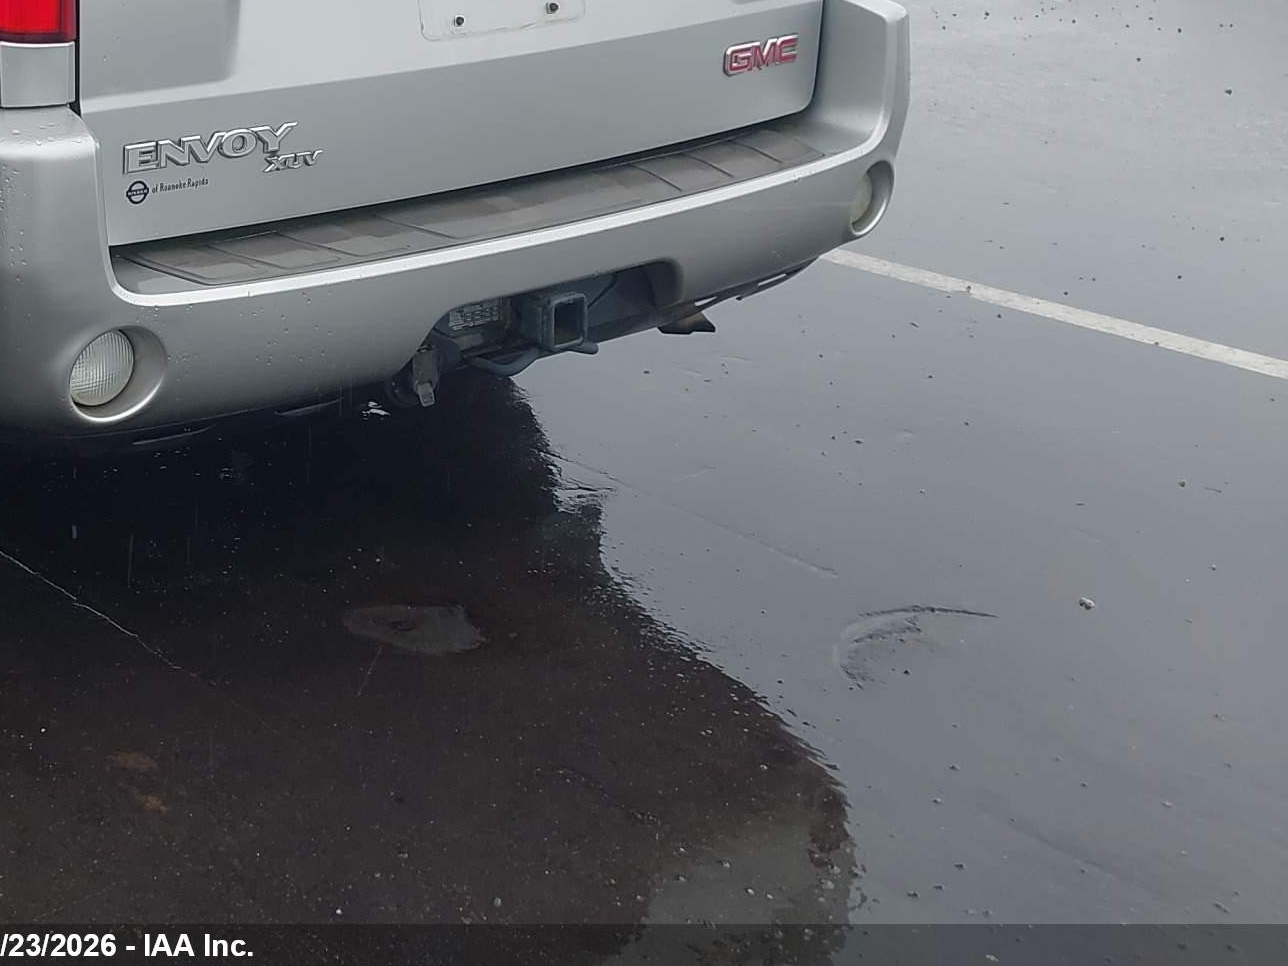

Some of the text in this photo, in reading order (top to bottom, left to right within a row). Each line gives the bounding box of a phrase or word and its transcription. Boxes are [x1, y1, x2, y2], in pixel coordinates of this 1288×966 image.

[723, 33, 799, 77] GMC
[123, 121, 297, 174] ENVOY
[263, 149, 324, 172] XUV
[151, 183, 158, 194] of
[159, 180, 186, 192] Roanoke
